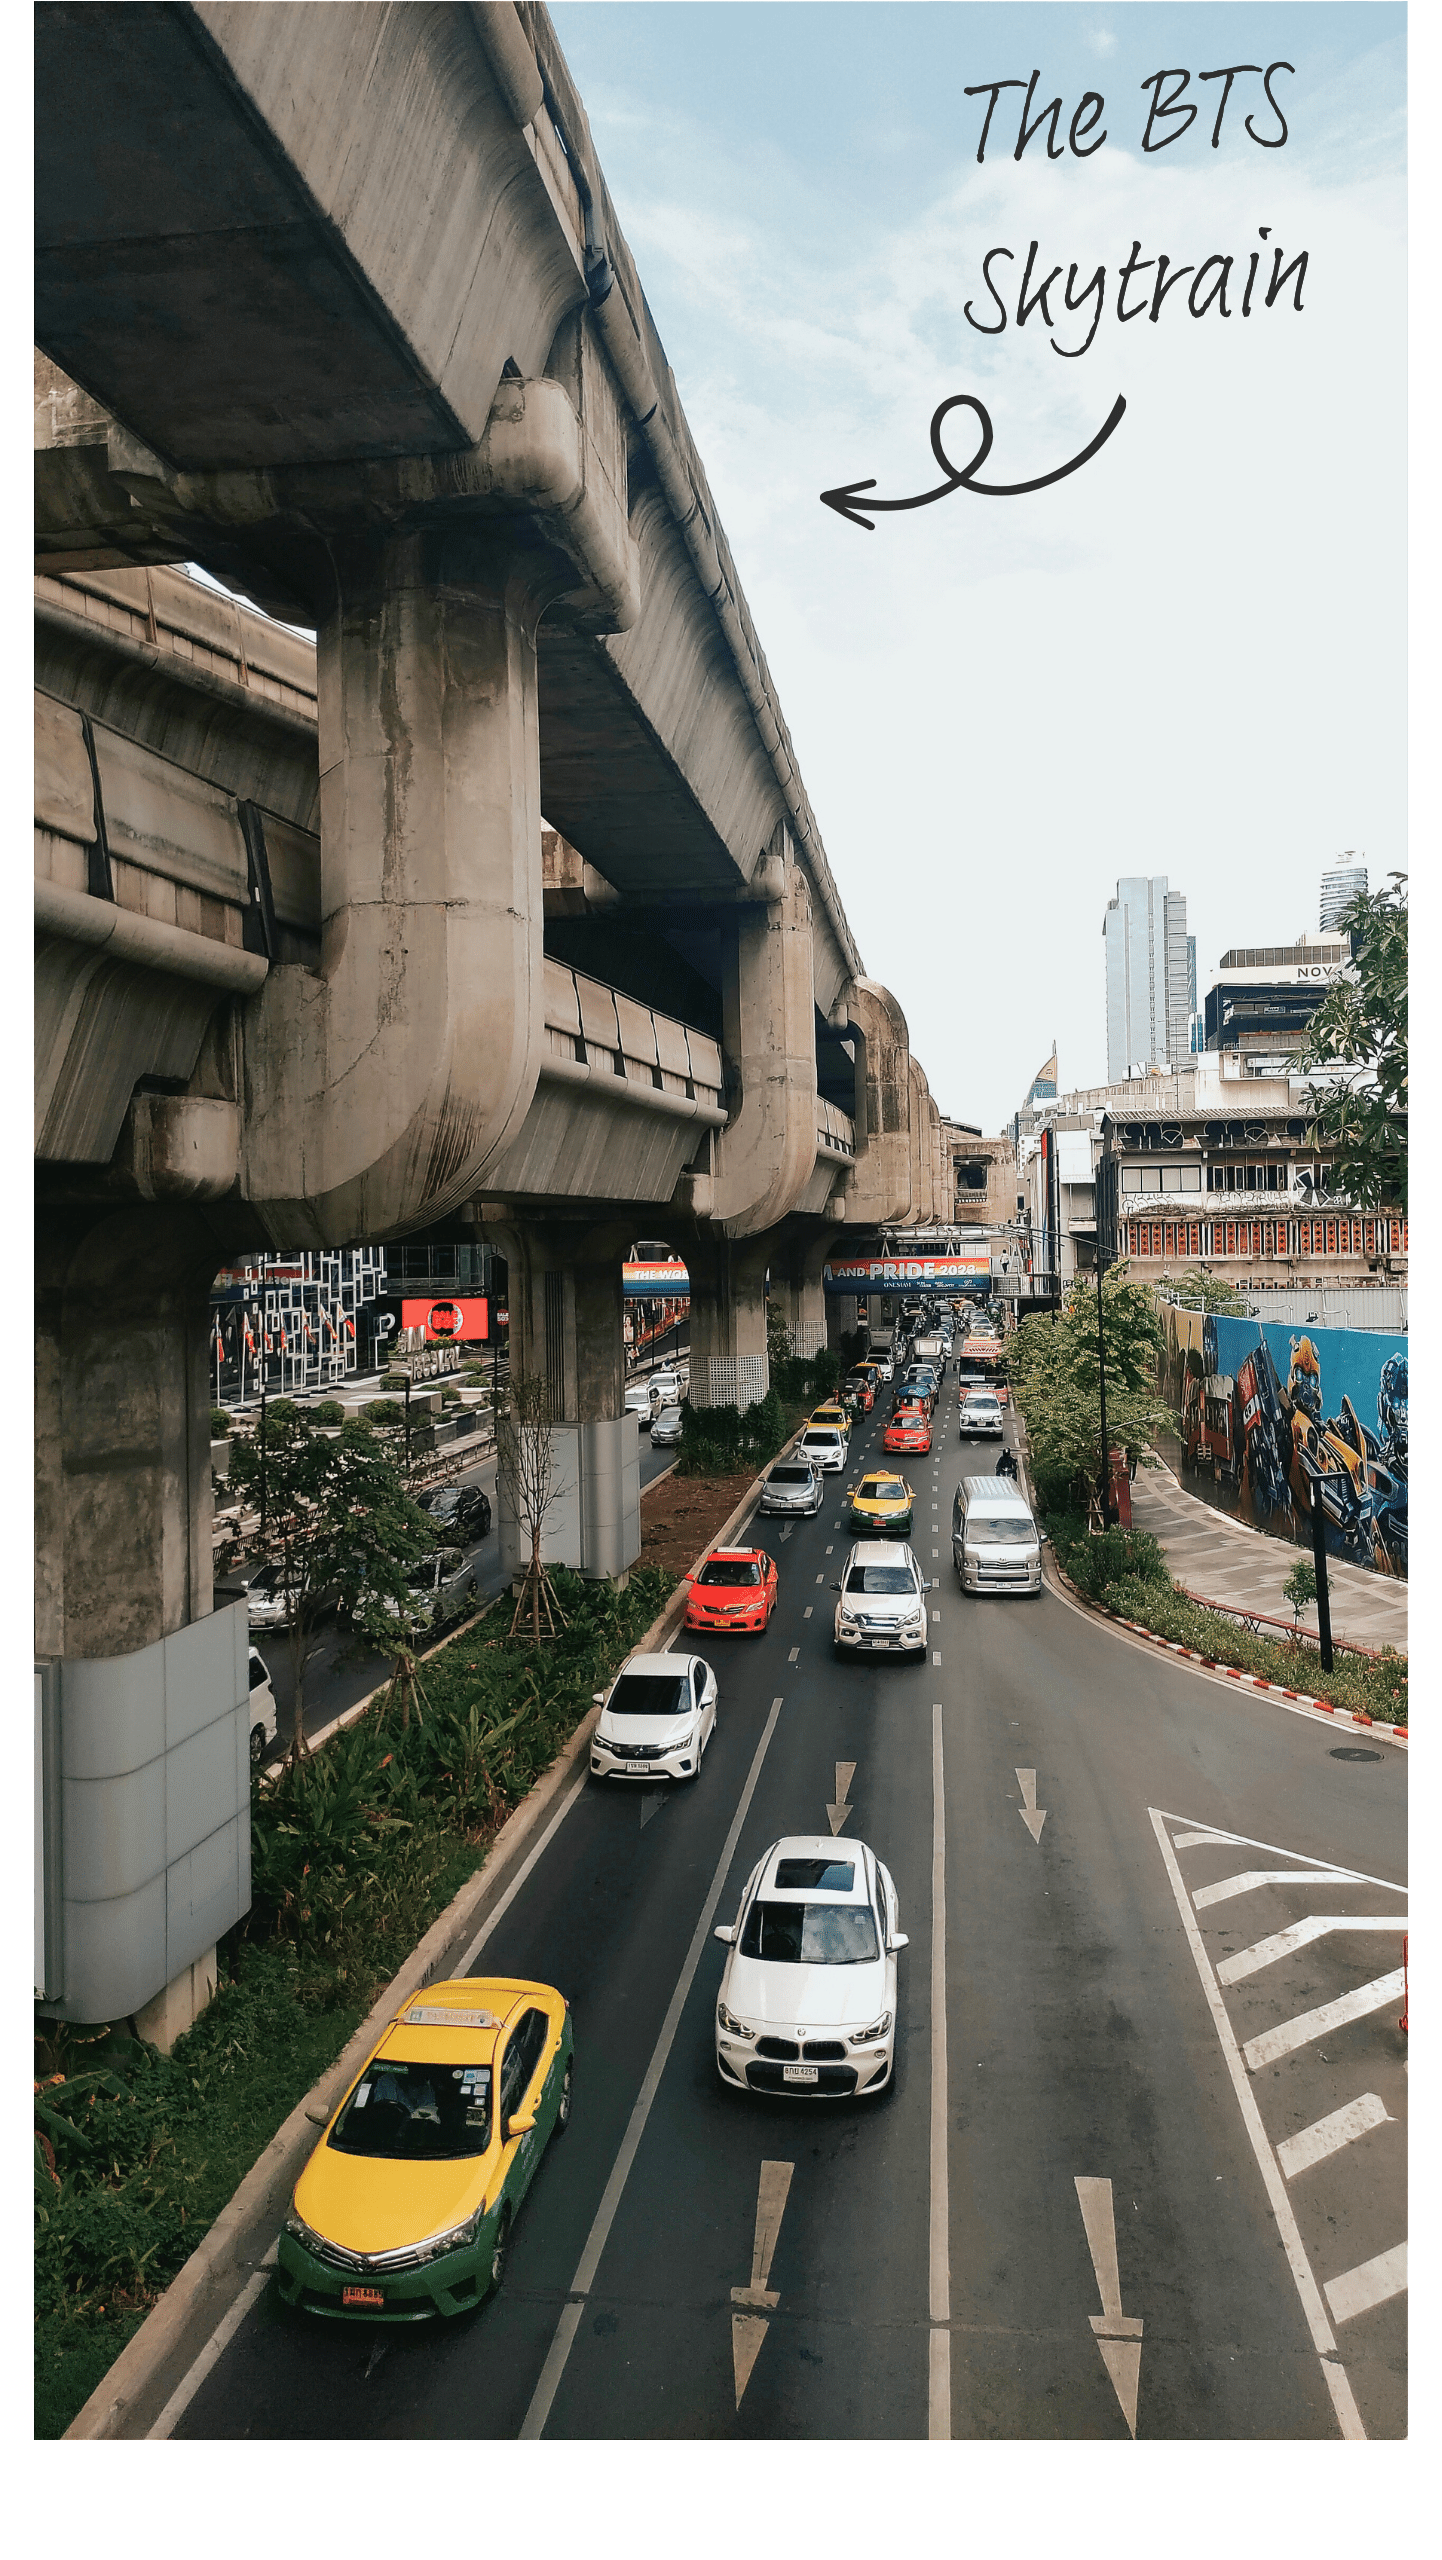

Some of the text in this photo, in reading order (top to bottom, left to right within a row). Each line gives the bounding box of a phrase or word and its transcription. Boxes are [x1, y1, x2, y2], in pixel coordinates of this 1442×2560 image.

[635, 1270, 656, 1280] THE
[838, 1268, 865, 1277] AND
[870, 1263, 935, 1280] PRIDE
